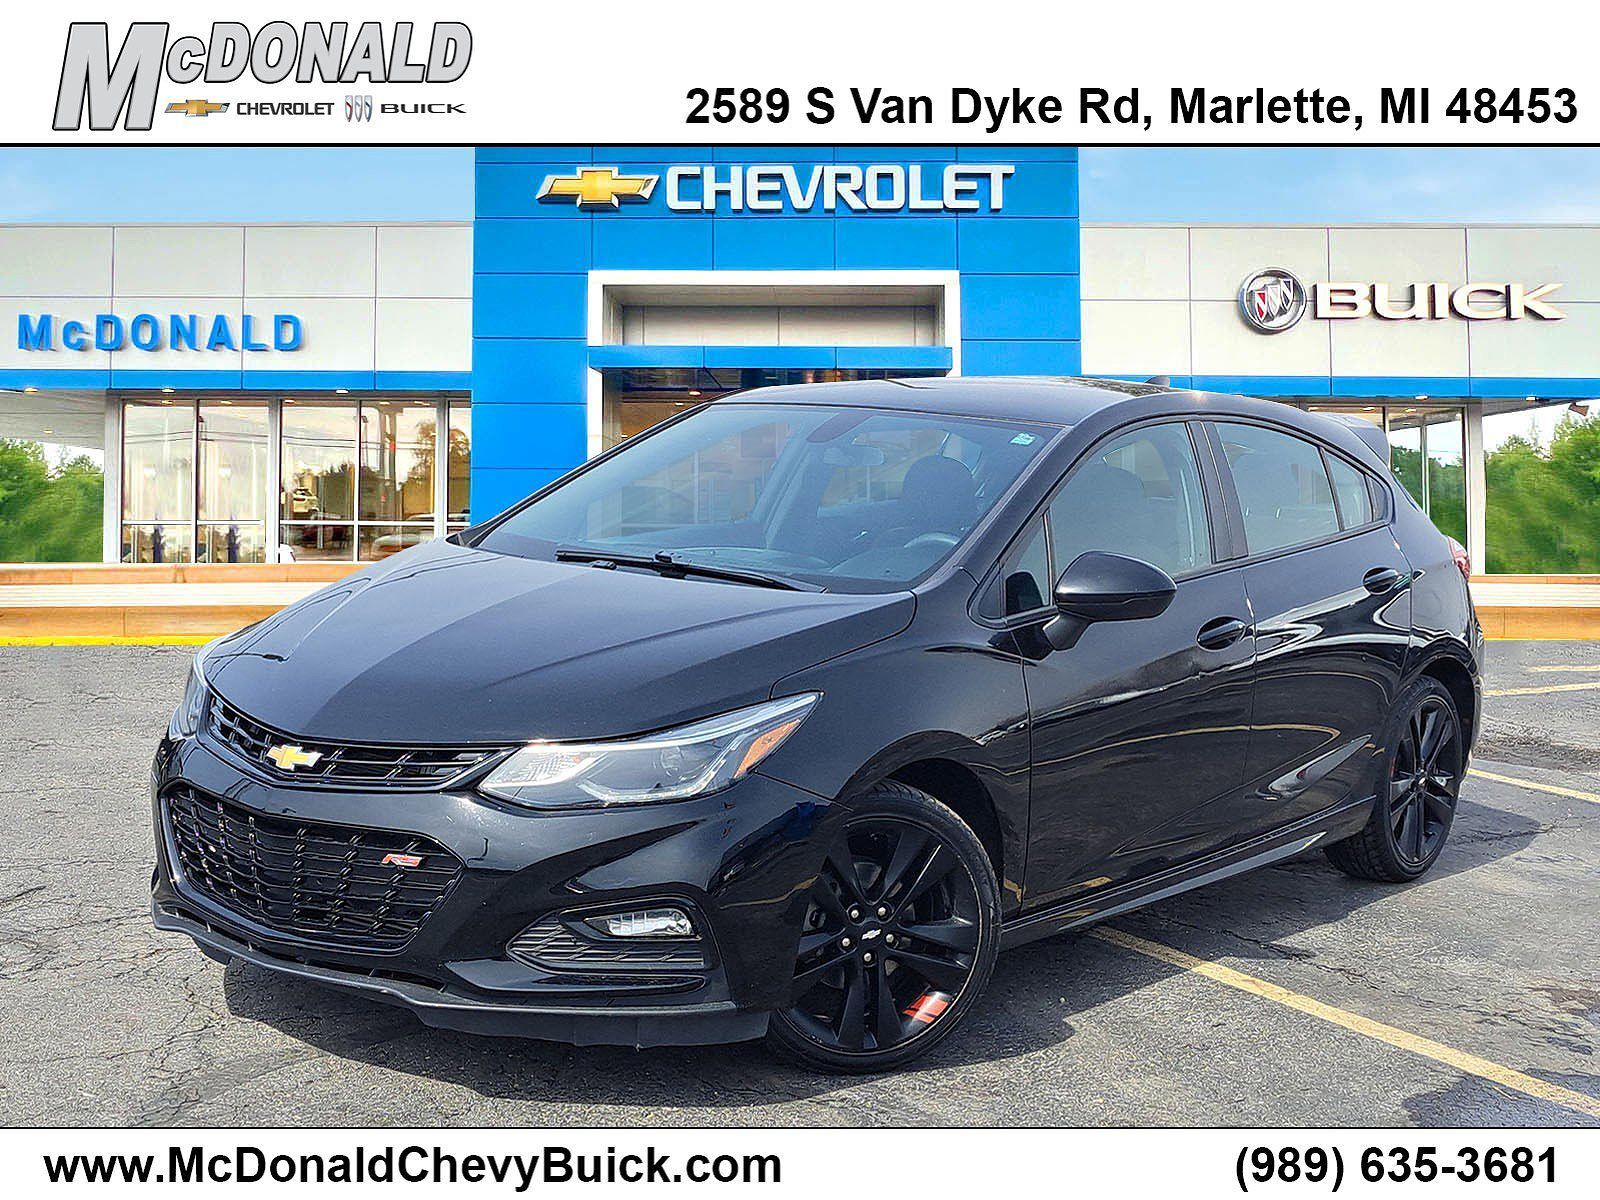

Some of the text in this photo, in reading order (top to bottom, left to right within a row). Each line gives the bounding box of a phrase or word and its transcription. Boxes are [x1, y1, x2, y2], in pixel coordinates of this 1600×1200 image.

[666, 164, 1015, 211] CHEVROLET
[1313, 281, 1567, 320] BUICK
[17, 313, 305, 352] McDONALD
[381, 853, 423, 867] RS
